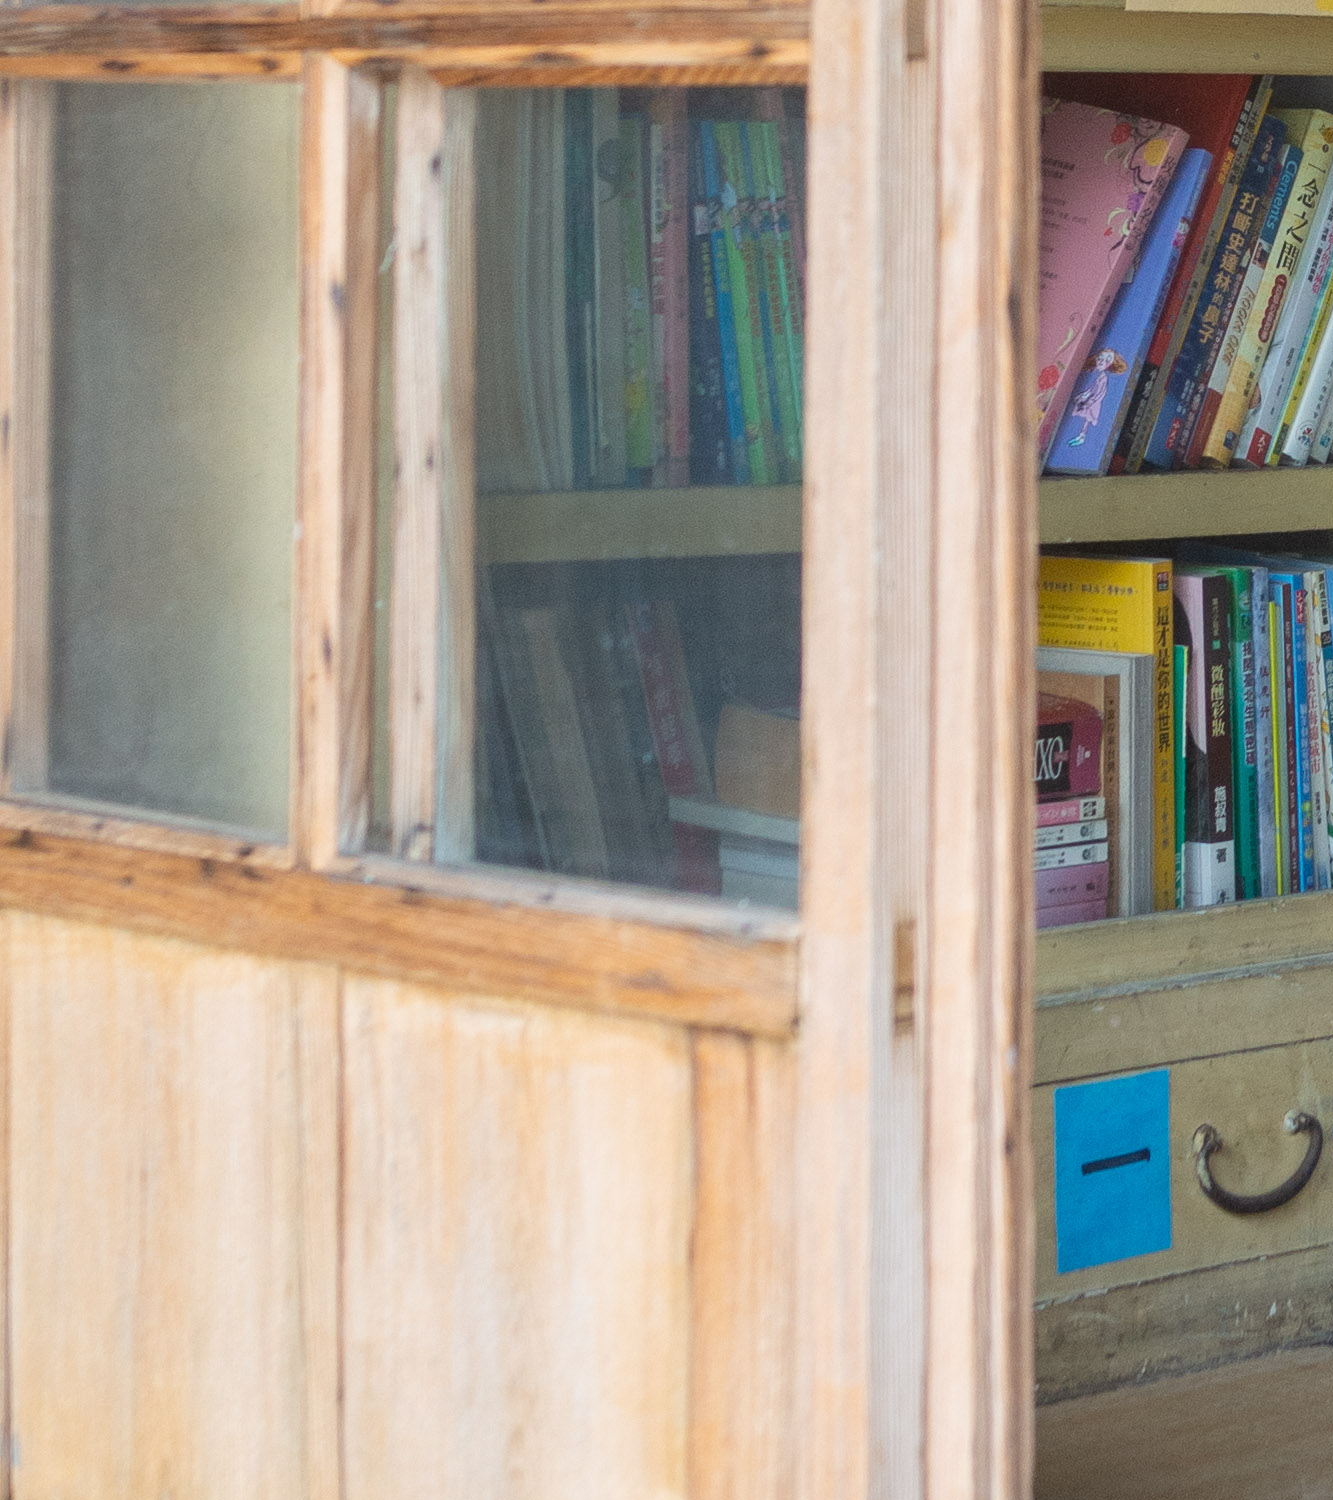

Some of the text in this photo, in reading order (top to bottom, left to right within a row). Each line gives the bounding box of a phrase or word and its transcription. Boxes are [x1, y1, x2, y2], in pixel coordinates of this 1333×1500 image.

[1266, 158, 1299, 230] Clements
[1276, 160, 1328, 276] 一念之間
[1155, 605, 1171, 754] 這才是你的世界
[1080, 1146, 1151, 1176] 一
